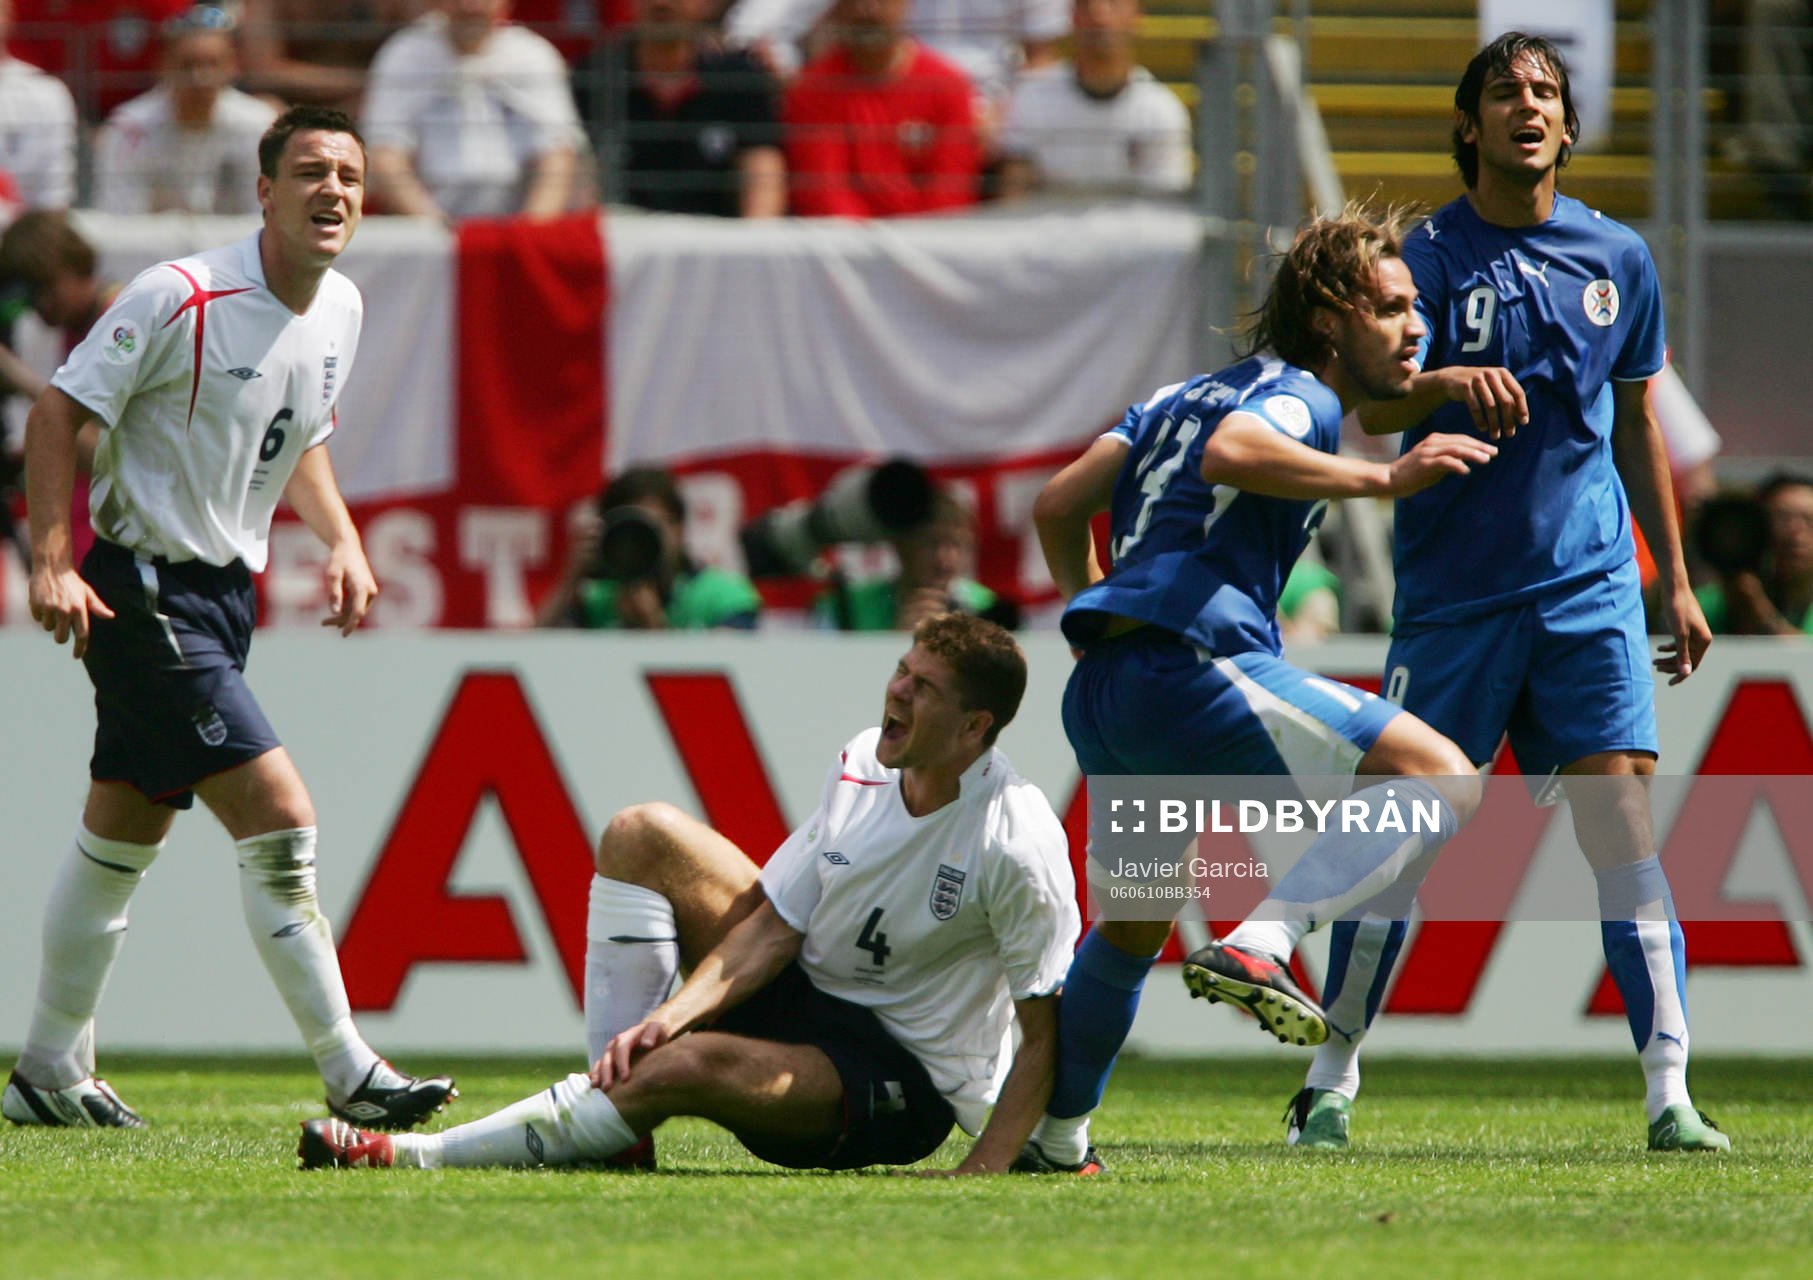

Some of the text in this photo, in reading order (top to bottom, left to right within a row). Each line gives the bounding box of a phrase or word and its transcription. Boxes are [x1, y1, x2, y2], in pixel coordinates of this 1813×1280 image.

[1461, 286, 1496, 352] 9
[259, 408, 294, 462] 6
[855, 906, 891, 966] 4
